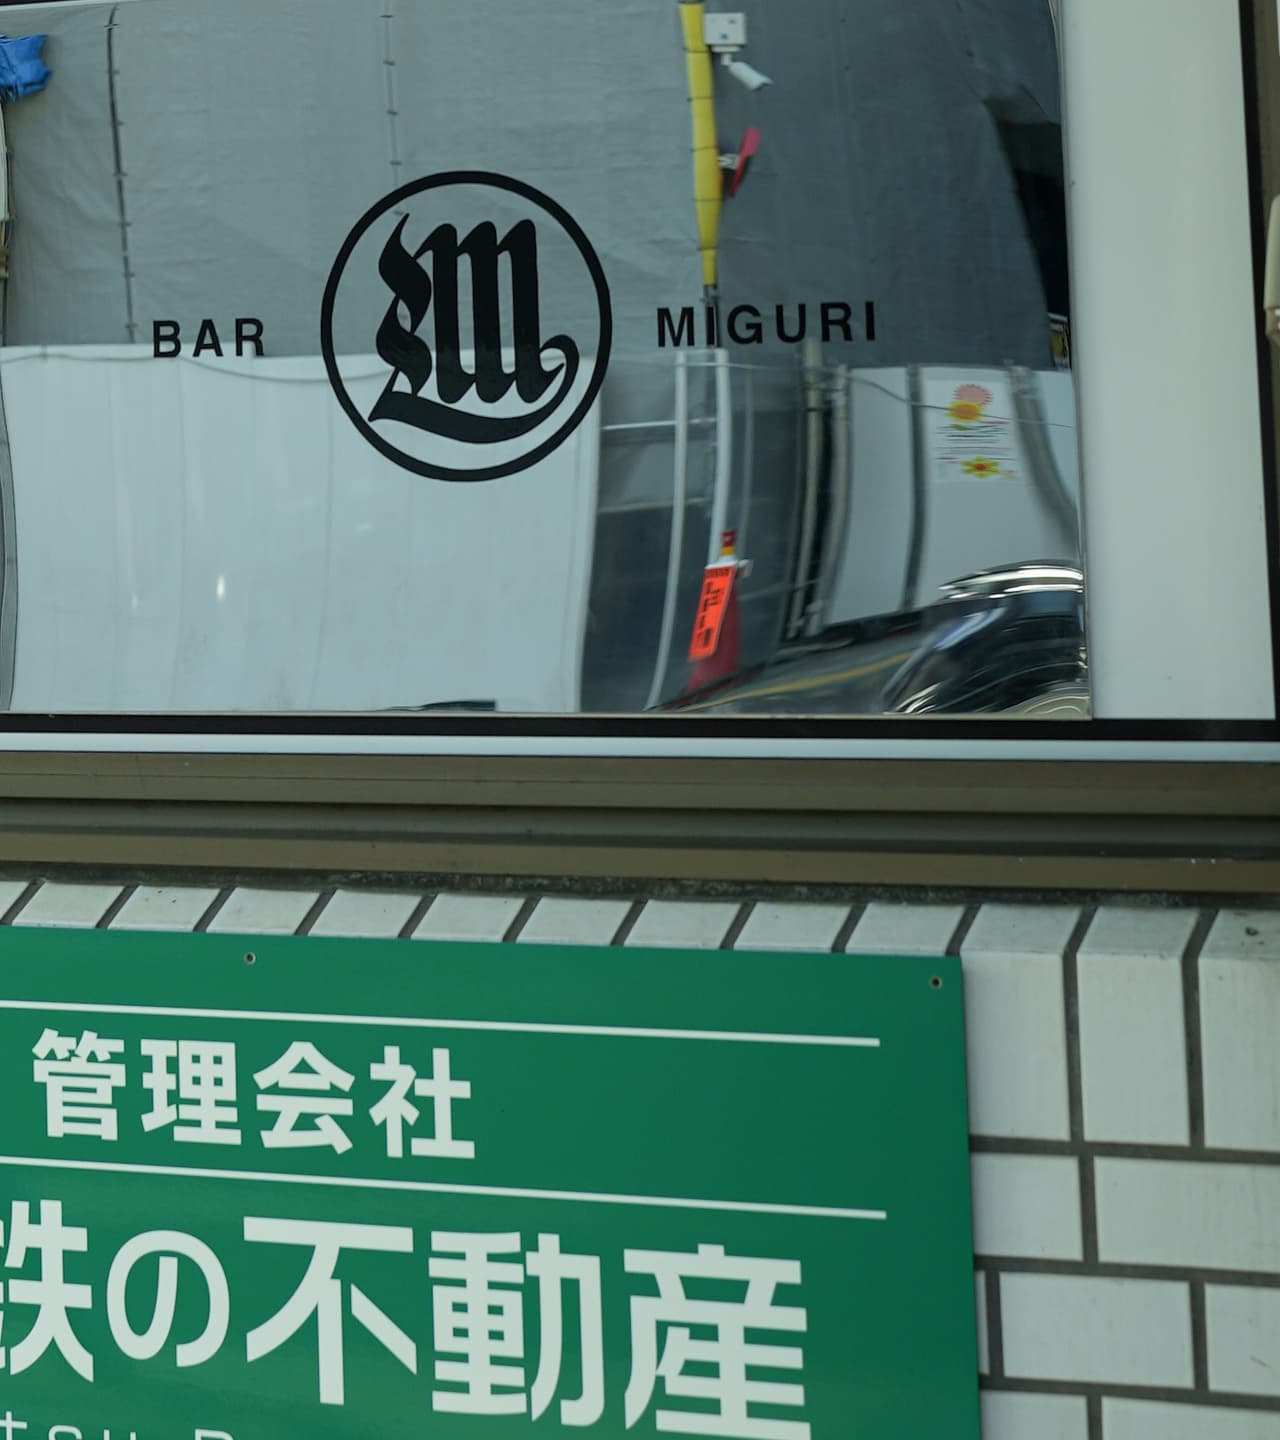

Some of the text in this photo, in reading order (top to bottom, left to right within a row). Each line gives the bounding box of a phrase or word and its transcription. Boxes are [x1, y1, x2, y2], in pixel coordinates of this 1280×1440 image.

[152, 317, 266, 359] BAR
[656, 300, 877, 347] MIGURI
[31, 1028, 476, 1161] 管理会社
